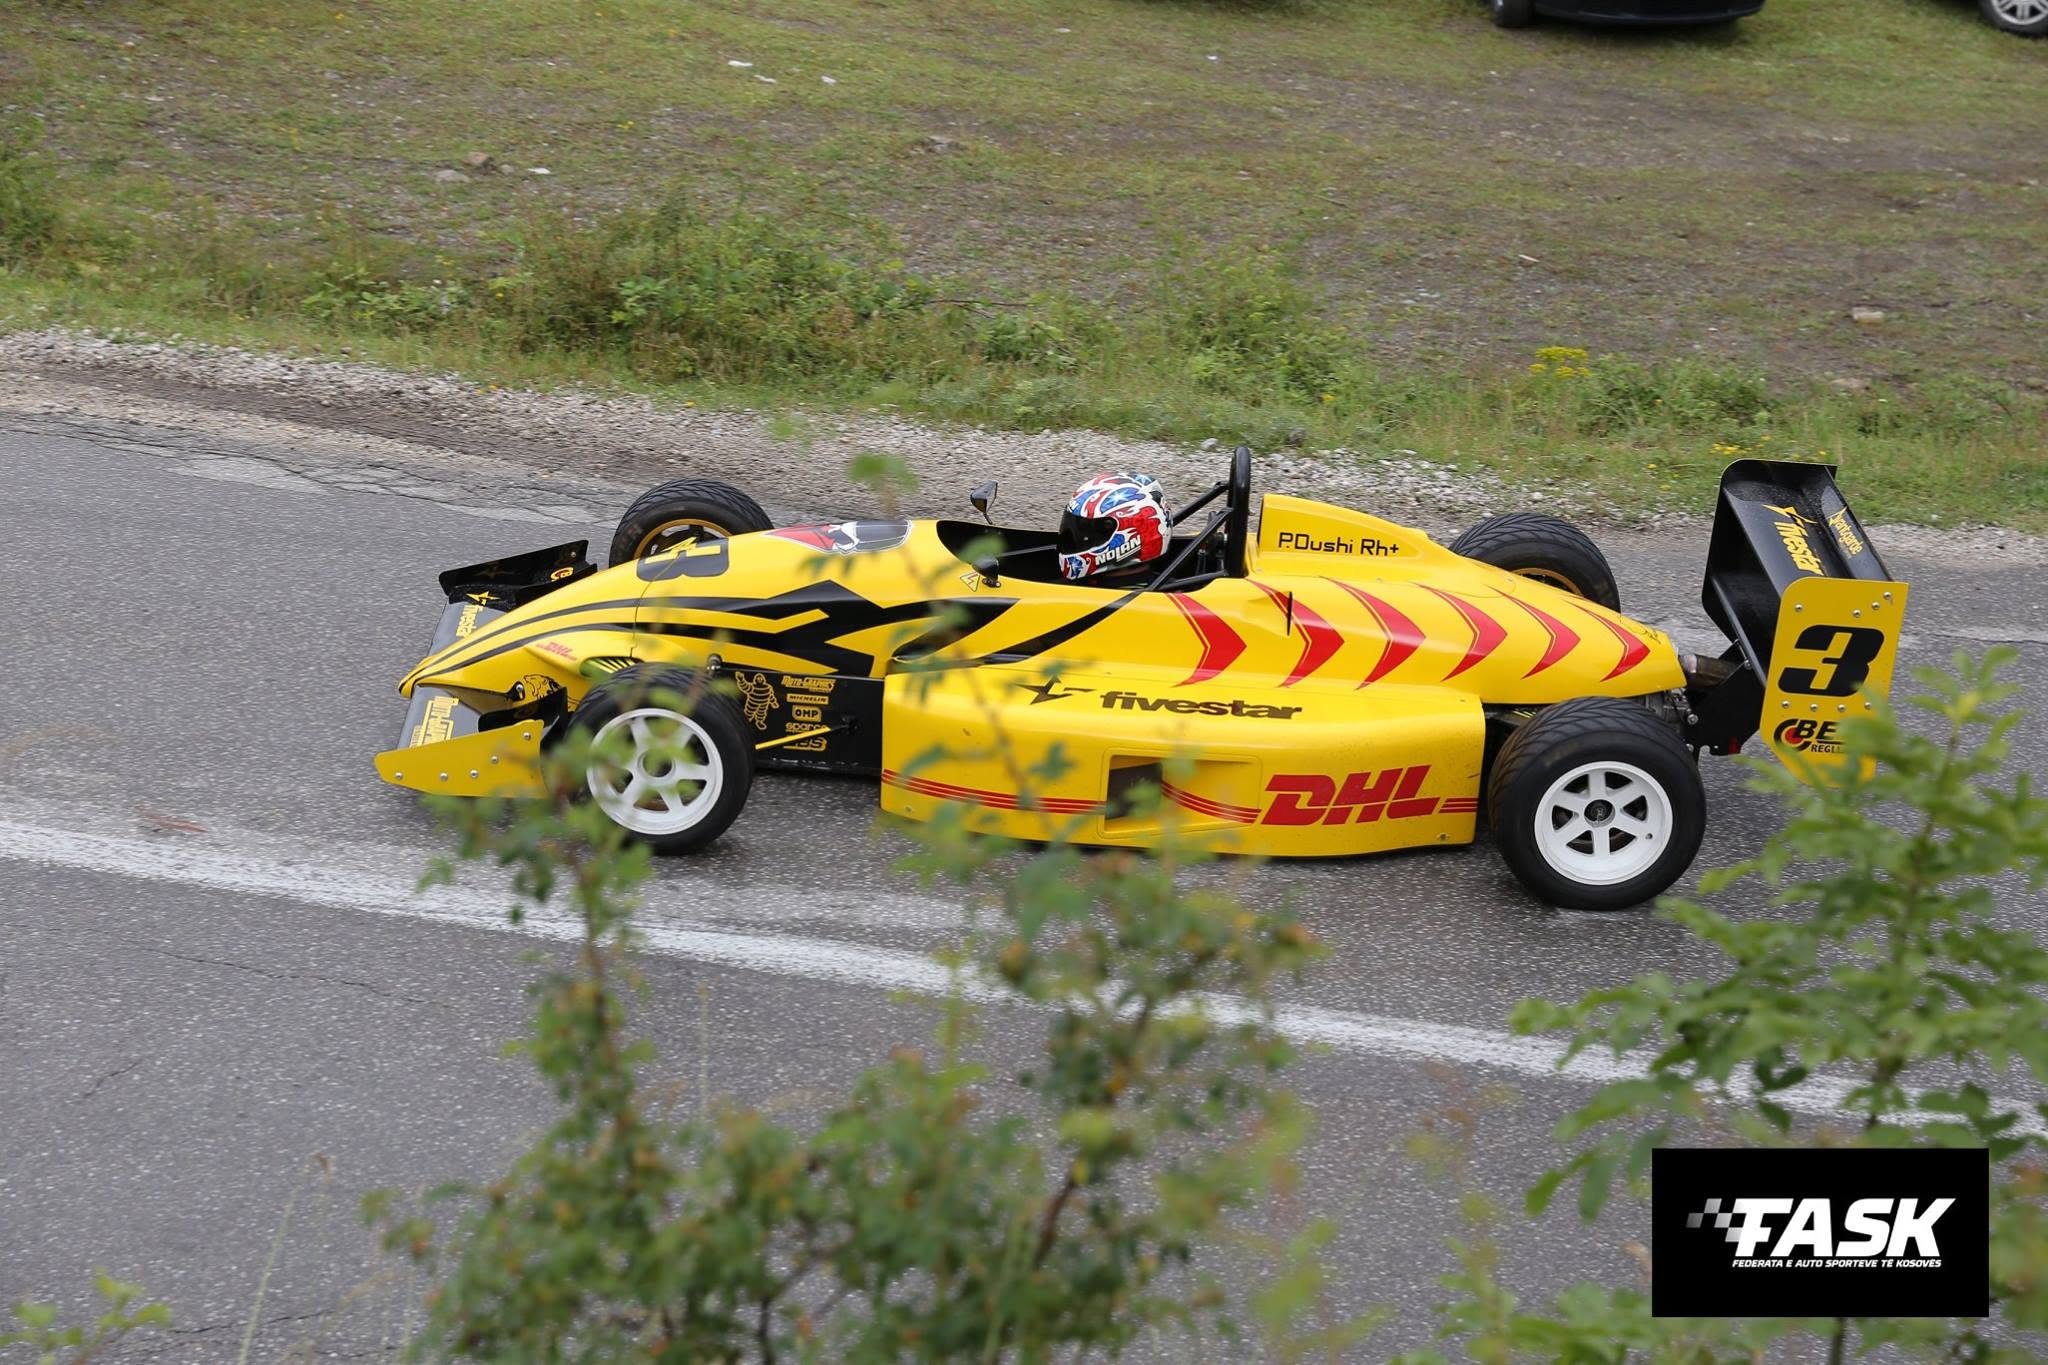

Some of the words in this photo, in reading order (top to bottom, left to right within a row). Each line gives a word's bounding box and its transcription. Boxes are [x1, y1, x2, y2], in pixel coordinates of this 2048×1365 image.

[1095, 534, 1141, 566] NOLAN
[1278, 532, 1353, 554] P.Dushi
[1360, 538, 1400, 556] Rh+
[1778, 624, 1885, 698] 3
[789, 694, 827, 703] MICHELIN
[1100, 691, 1303, 719] fivestar
[795, 708, 819, 718] OMP
[1260, 765, 1440, 826] DHL
